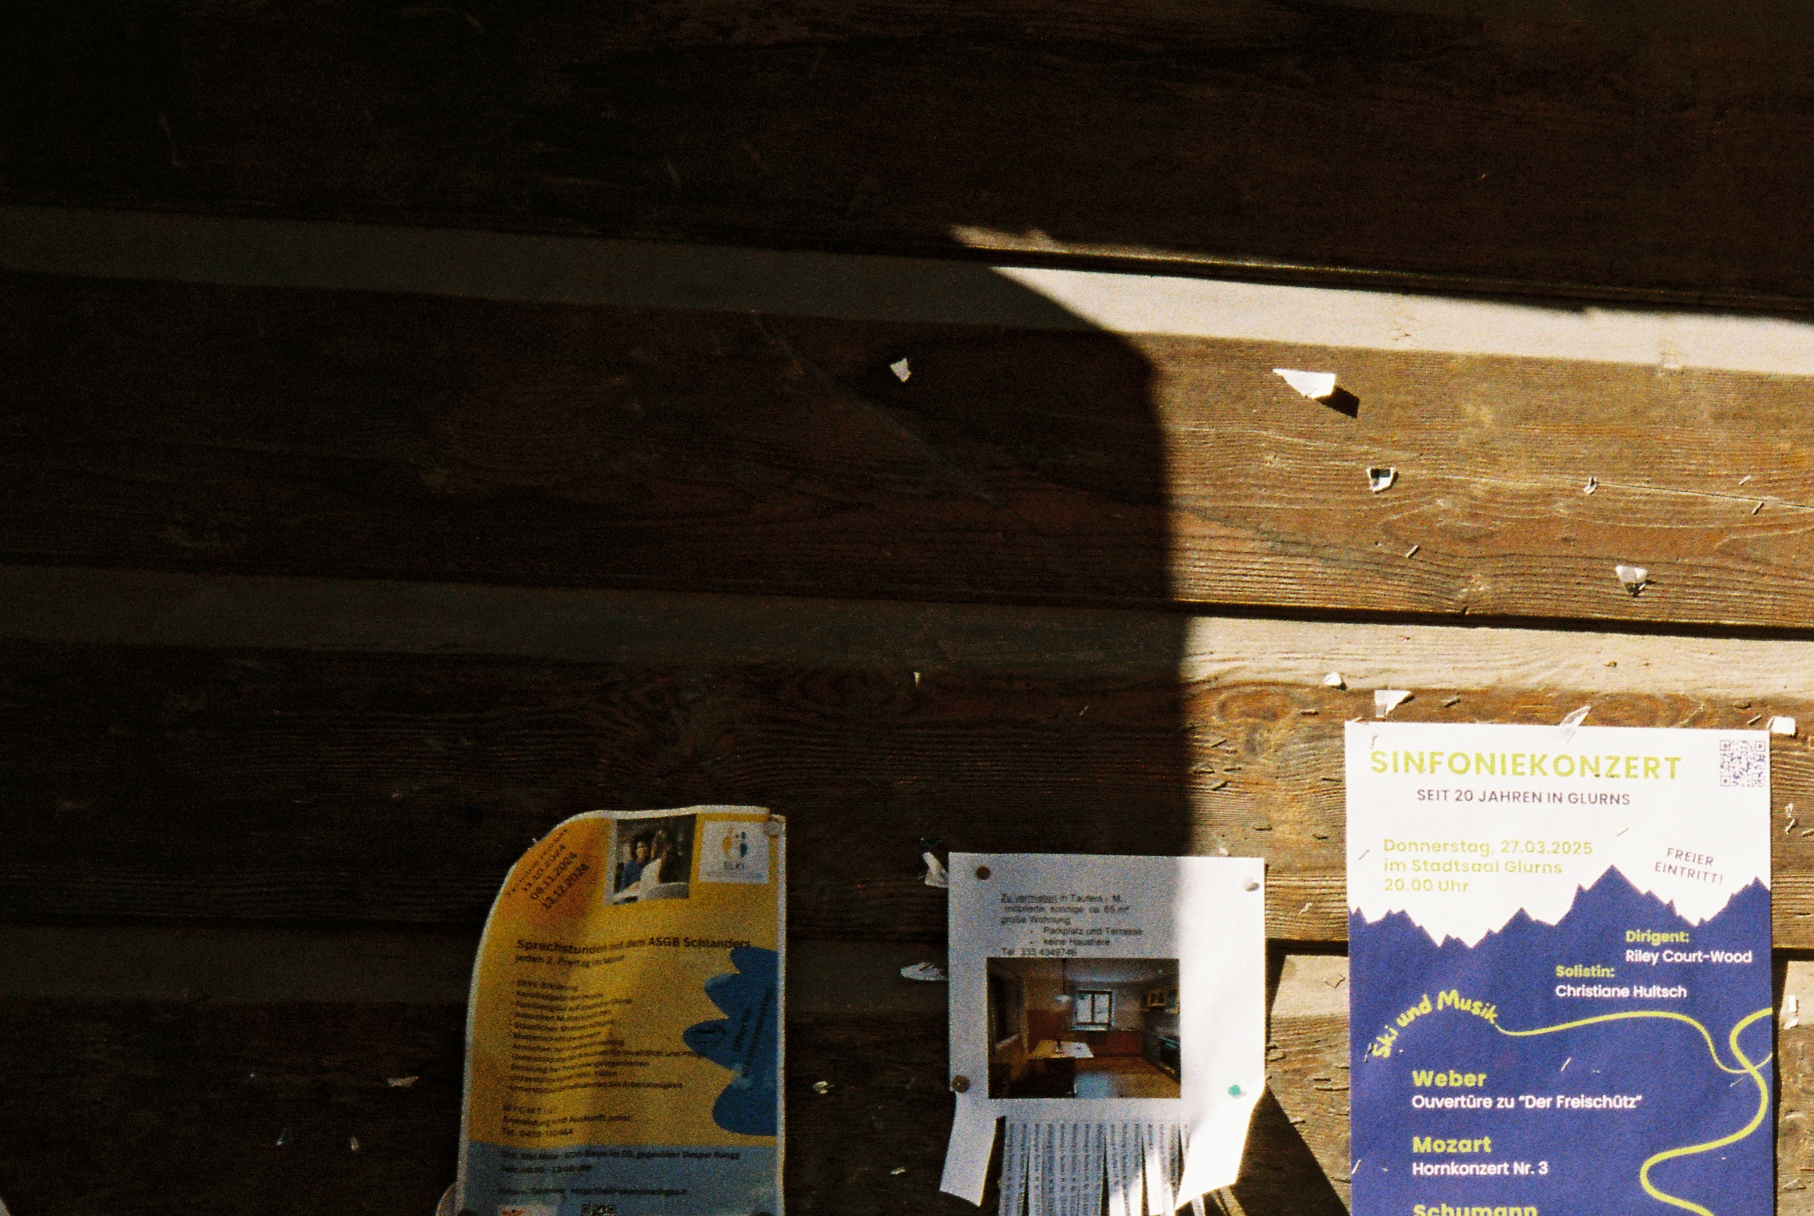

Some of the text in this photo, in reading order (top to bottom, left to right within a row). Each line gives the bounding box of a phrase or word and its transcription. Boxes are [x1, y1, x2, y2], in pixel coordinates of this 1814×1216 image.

[1369, 749, 1682, 779] SINFONIEKONZERT
[1416, 788, 1631, 806] SEIT 20 JAHREN IN GLURNS
[1383, 838, 1593, 856] Donnerstag, 27.03.2025
[1383, 858, 1562, 874] im Stadtsaal Glurns
[1666, 847, 1715, 868] FREIER
[1654, 860, 1724, 886] EINTRITT!
[542, 862, 590, 911] 13.12.2024
[1383, 878, 1469, 893] 20.00 Uhr
[1043, 927, 1084, 937] Parkplatz
[1105, 926, 1143, 936] Terrasse
[1625, 929, 1690, 945] Dirigent:
[648, 937, 680, 948] ASGB
[683, 936, 751, 949] Schlanders
[1625, 949, 1752, 966] Riley Court-Wood
[1555, 964, 1615, 979] Solistin:
[1555, 984, 1688, 999] Christiane Hultsch
[1372, 989, 1499, 1058] Ski und Musik
[1412, 1070, 1487, 1088] Weber
[1412, 1093, 1493, 1109] Ouvertüre
[1497, 1096, 1515, 1109] zu
[1412, 1136, 1492, 1153] Mozart
[1412, 1161, 1549, 1176] Hornkonzert Nr. 3
